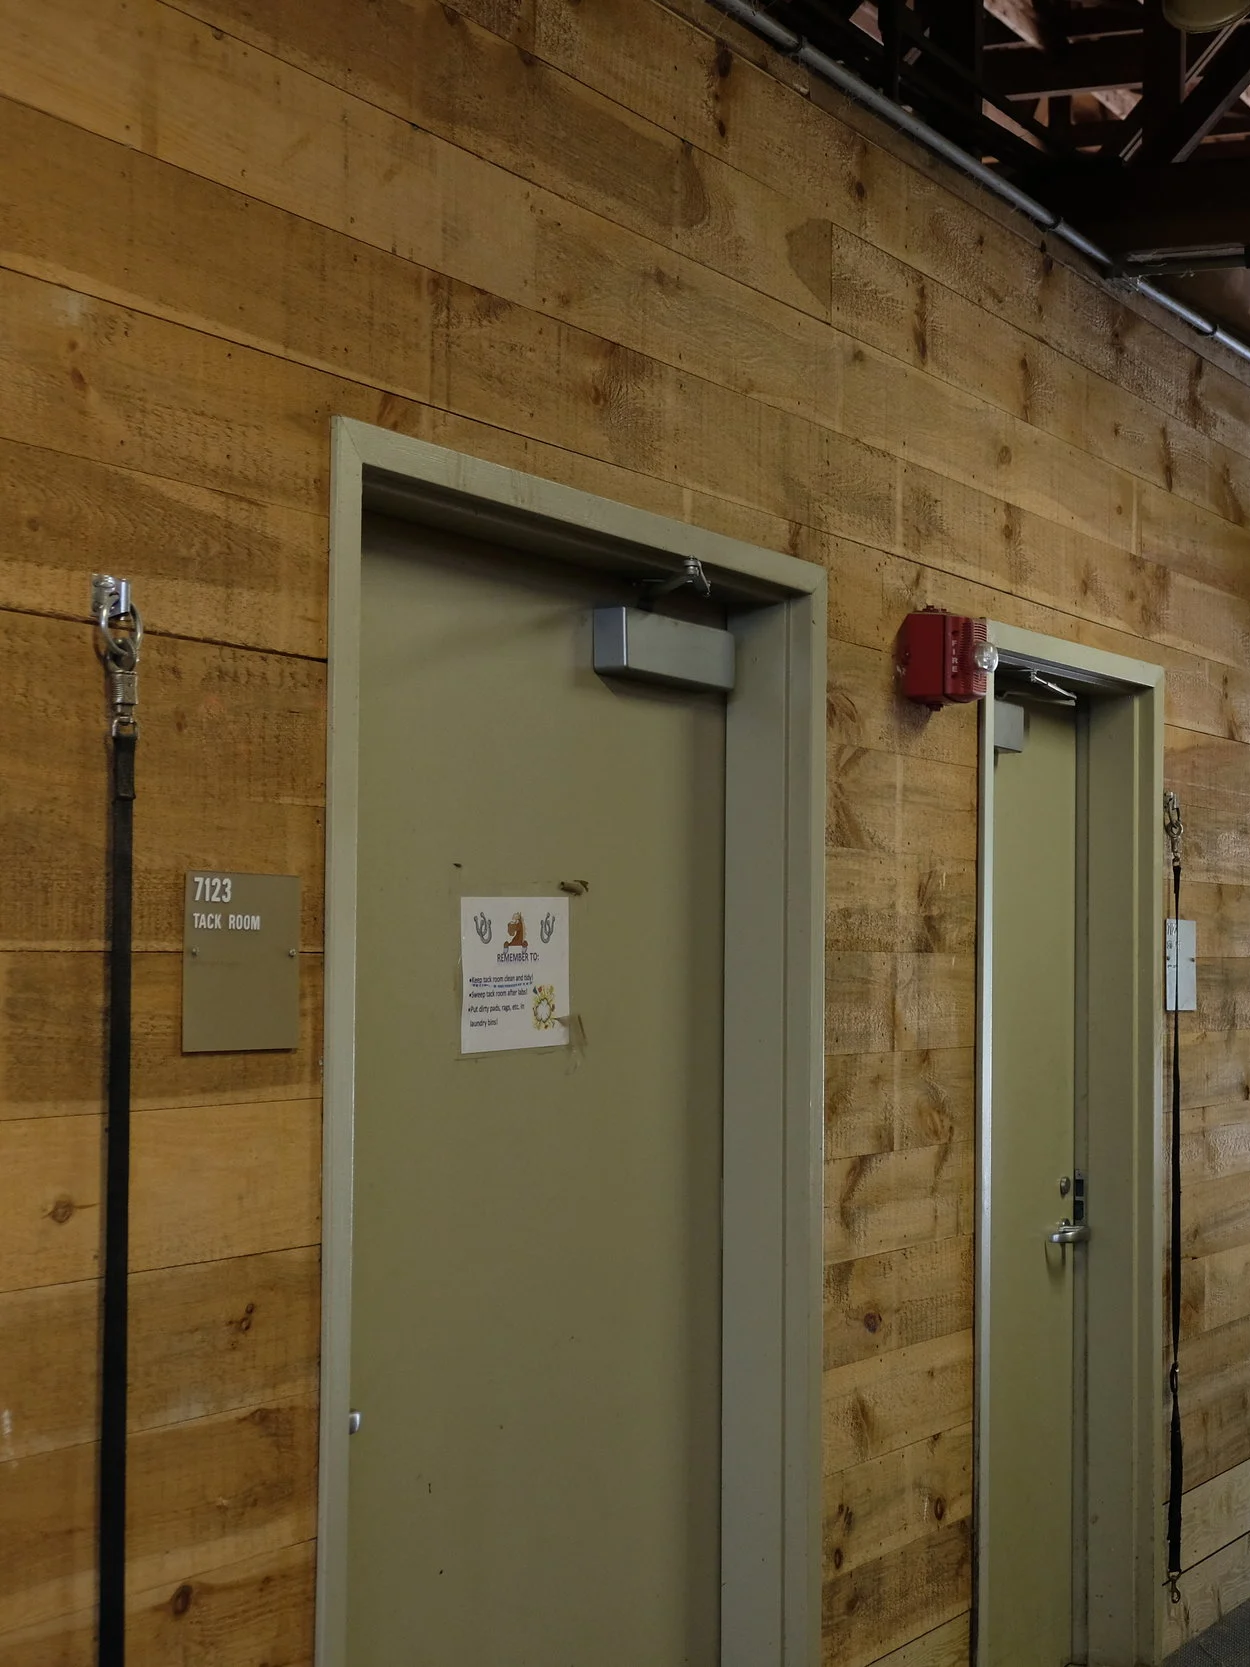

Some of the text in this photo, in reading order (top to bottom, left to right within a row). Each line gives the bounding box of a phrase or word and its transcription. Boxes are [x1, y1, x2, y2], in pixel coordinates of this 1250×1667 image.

[194, 877, 231, 902] 7123
[193, 913, 260, 930] TACK ROOM
[497, 952, 539, 962] REMEMBER TO:
[524, 973, 533, 983] tidy!
[479, 1005, 489, 1014] dirty
[470, 1018, 487, 1028] laundry
